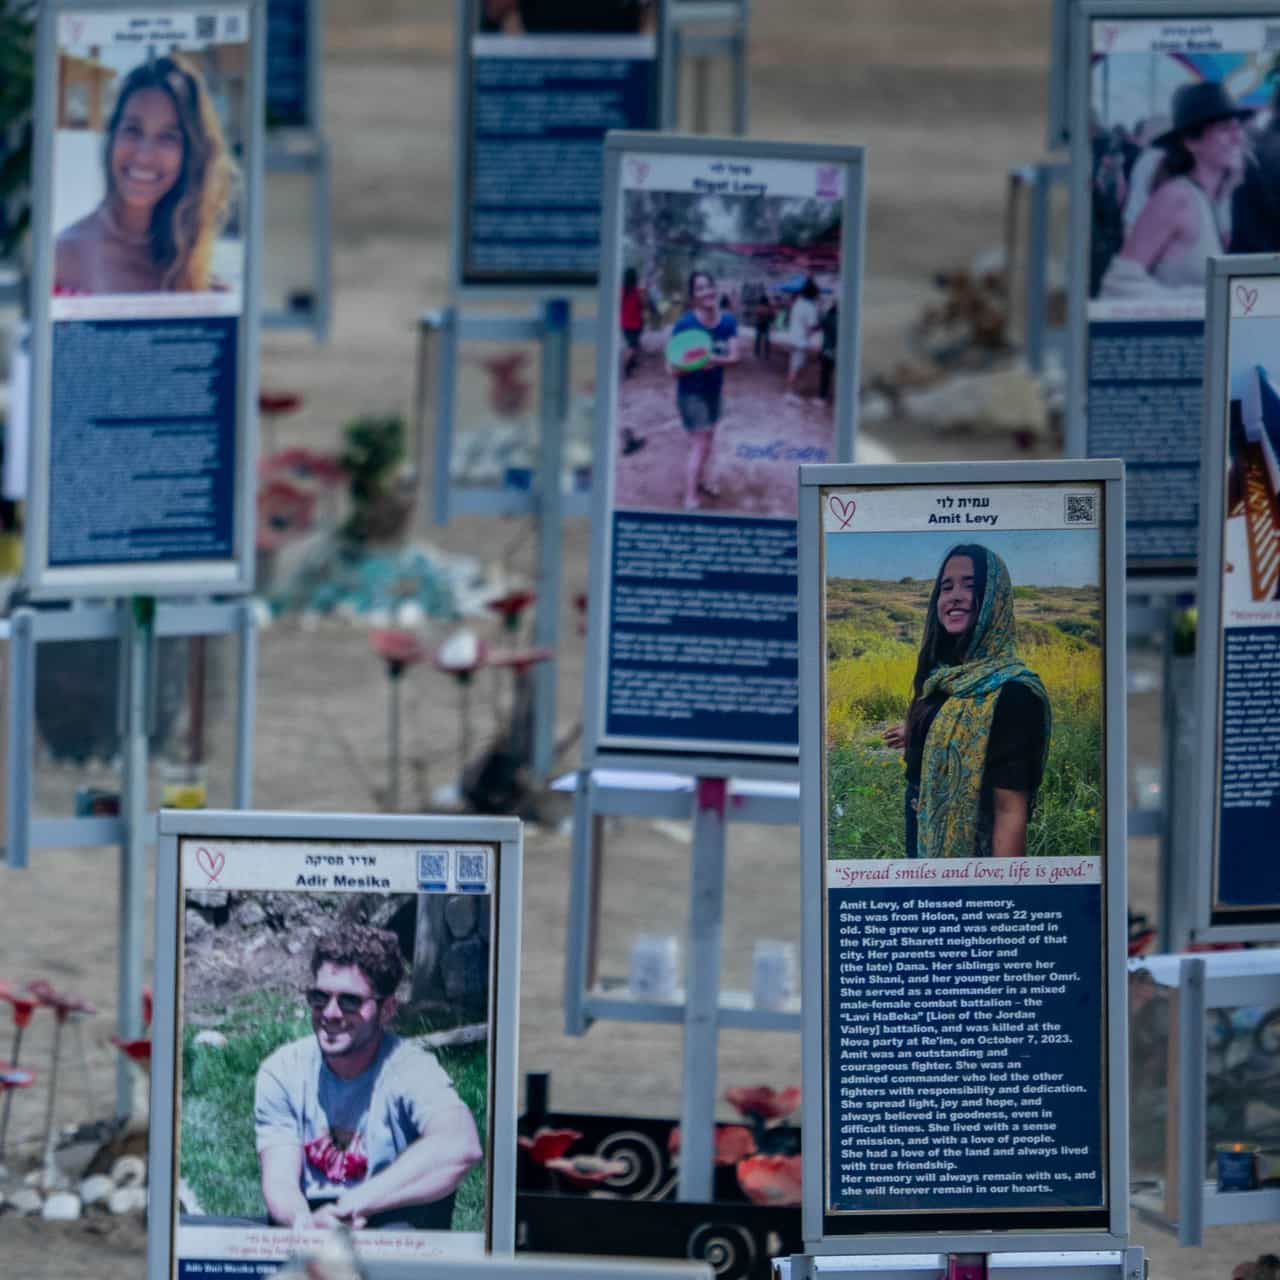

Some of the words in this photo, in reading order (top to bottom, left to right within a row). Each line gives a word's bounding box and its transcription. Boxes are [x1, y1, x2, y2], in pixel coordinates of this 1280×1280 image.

[937, 496, 954, 508] לוי
[958, 498, 990, 508] עמית
[929, 513, 961, 524] Amit
[966, 513, 998, 526] Levy
[306, 856, 344, 867] מסיקה
[348, 856, 376, 865] אדיר
[896, 866, 938, 880] smiles
[941, 862, 973, 879] and
[974, 862, 1006, 880] love;
[1007, 861, 1034, 881] life
[1034, 867, 1048, 878] is
[297, 875, 327, 886] Adir
[334, 875, 390, 888] Mesika
[840, 901, 867, 909] Amit
[903, 900, 915, 908] of
[918, 899, 963, 908] blessed
[840, 913, 862, 922] She
[891, 912, 919, 921] from
[962, 912, 983, 920] and
[1013, 911, 1027, 919] 22
[1030, 912, 1062, 921] years
[864, 925, 886, 934] She
[889, 927, 919, 936] grew
[922, 926, 936, 936] up
[939, 924, 961, 933] and
[990, 923, 1045, 932] educated
[1048, 923, 1058, 931] in
[840, 938, 859, 947] the
[862, 937, 898, 949] Kiryat
[901, 937, 944, 946] Sharett
[947, 936, 1026, 948] neighborhood
[1029, 935, 1040, 944] of
[1044, 936, 1067, 944] that
[868, 950, 888, 959] Her
[891, 950, 936, 961] parents
[971, 949, 993, 957] Lior
[997, 948, 1018, 957] and
[840, 963, 863, 973] (the
[866, 963, 893, 973] late)
[932, 962, 953, 970] Her
[956, 961, 1000, 973] siblings
[1036, 960, 1054, 968] her
[840, 976, 866, 984] twin
[908, 975, 930, 983] and
[932, 974, 951, 983] her
[954, 976, 1000, 985] younger
[1004, 973, 1046, 981] brother
[840, 988, 862, 997] She
[865, 987, 905, 996] served
[935, 986, 1003, 995] commander
[1006, 986, 1017, 994] in
[1030, 985, 1066, 994] mixed
[840, 1000, 911, 1009] male-female
[914, 1000, 958, 1008] combat
[960, 998, 1012, 1007] battalion
[1024, 998, 1042, 1006] the
[926, 1011, 955, 1022] [Lion
[959, 1011, 970, 1020] of
[974, 1011, 992, 1019] the
[996, 1011, 1036, 1019] Jordan
